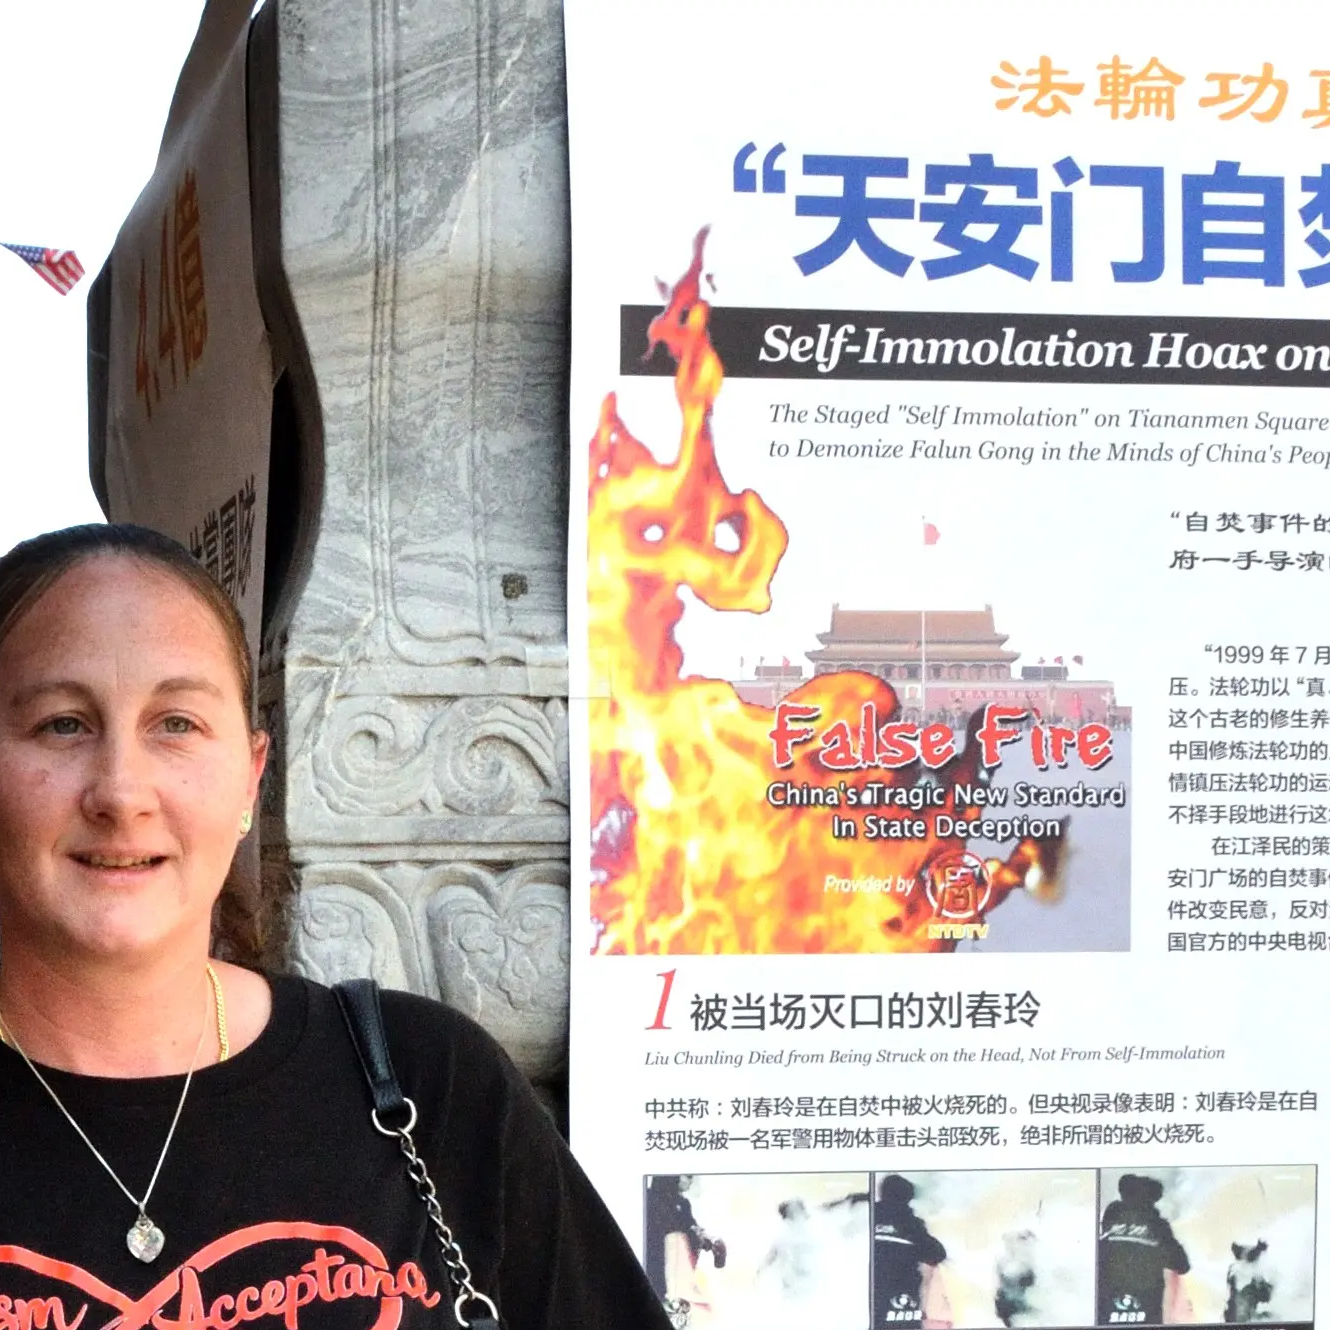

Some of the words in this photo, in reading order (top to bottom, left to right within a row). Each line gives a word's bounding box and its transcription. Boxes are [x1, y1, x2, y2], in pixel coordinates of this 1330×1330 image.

[758, 323, 1134, 373] Self-Immolation
[1142, 332, 1268, 370] Hoax
[769, 403, 808, 423] The
[814, 404, 890, 428] Staged
[1094, 413, 1120, 427] on
[1128, 408, 1248, 429] Tiananmen
[1254, 411, 1329, 435] Square
[769, 440, 789, 457] to
[796, 438, 903, 458] Demonize
[909, 439, 971, 459] Falun
[978, 440, 1034, 465] Gong
[1041, 441, 1060, 460] in
[1068, 440, 1101, 461] the
[1106, 441, 1173, 461] Minds
[1179, 442, 1204, 467] of
[1205, 442, 1282, 463] China's
[769, 701, 955, 768] False
[977, 700, 1114, 769] Fire
[768, 783, 858, 805] China's
[867, 784, 944, 811] Tragic
[954, 785, 1008, 805] New
[1014, 782, 1125, 806] Standard
[833, 817, 854, 837] In
[865, 817, 925, 838] State
[936, 817, 1060, 844] Deception
[825, 875, 888, 894] Provided
[894, 876, 915, 897] by
[644, 968, 676, 1030] 1
[690, 990, 1040, 1031] 被当场灭口的刘春玲
[644, 1051, 669, 1065] Liu
[673, 1050, 743, 1068] Chunling
[747, 1049, 784, 1064] Died
[783, 1049, 824, 1067] from
[829, 1049, 872, 1066] Being
[875, 1047, 926, 1063] Struck
[929, 1052, 948, 1062] on
[953, 1047, 976, 1062] the
[980, 1047, 1024, 1063] Head,
[1028, 1047, 1056, 1061] Not
[1060, 1047, 1101, 1060] From
[1104, 1045, 1225, 1063] Self-Immolation
